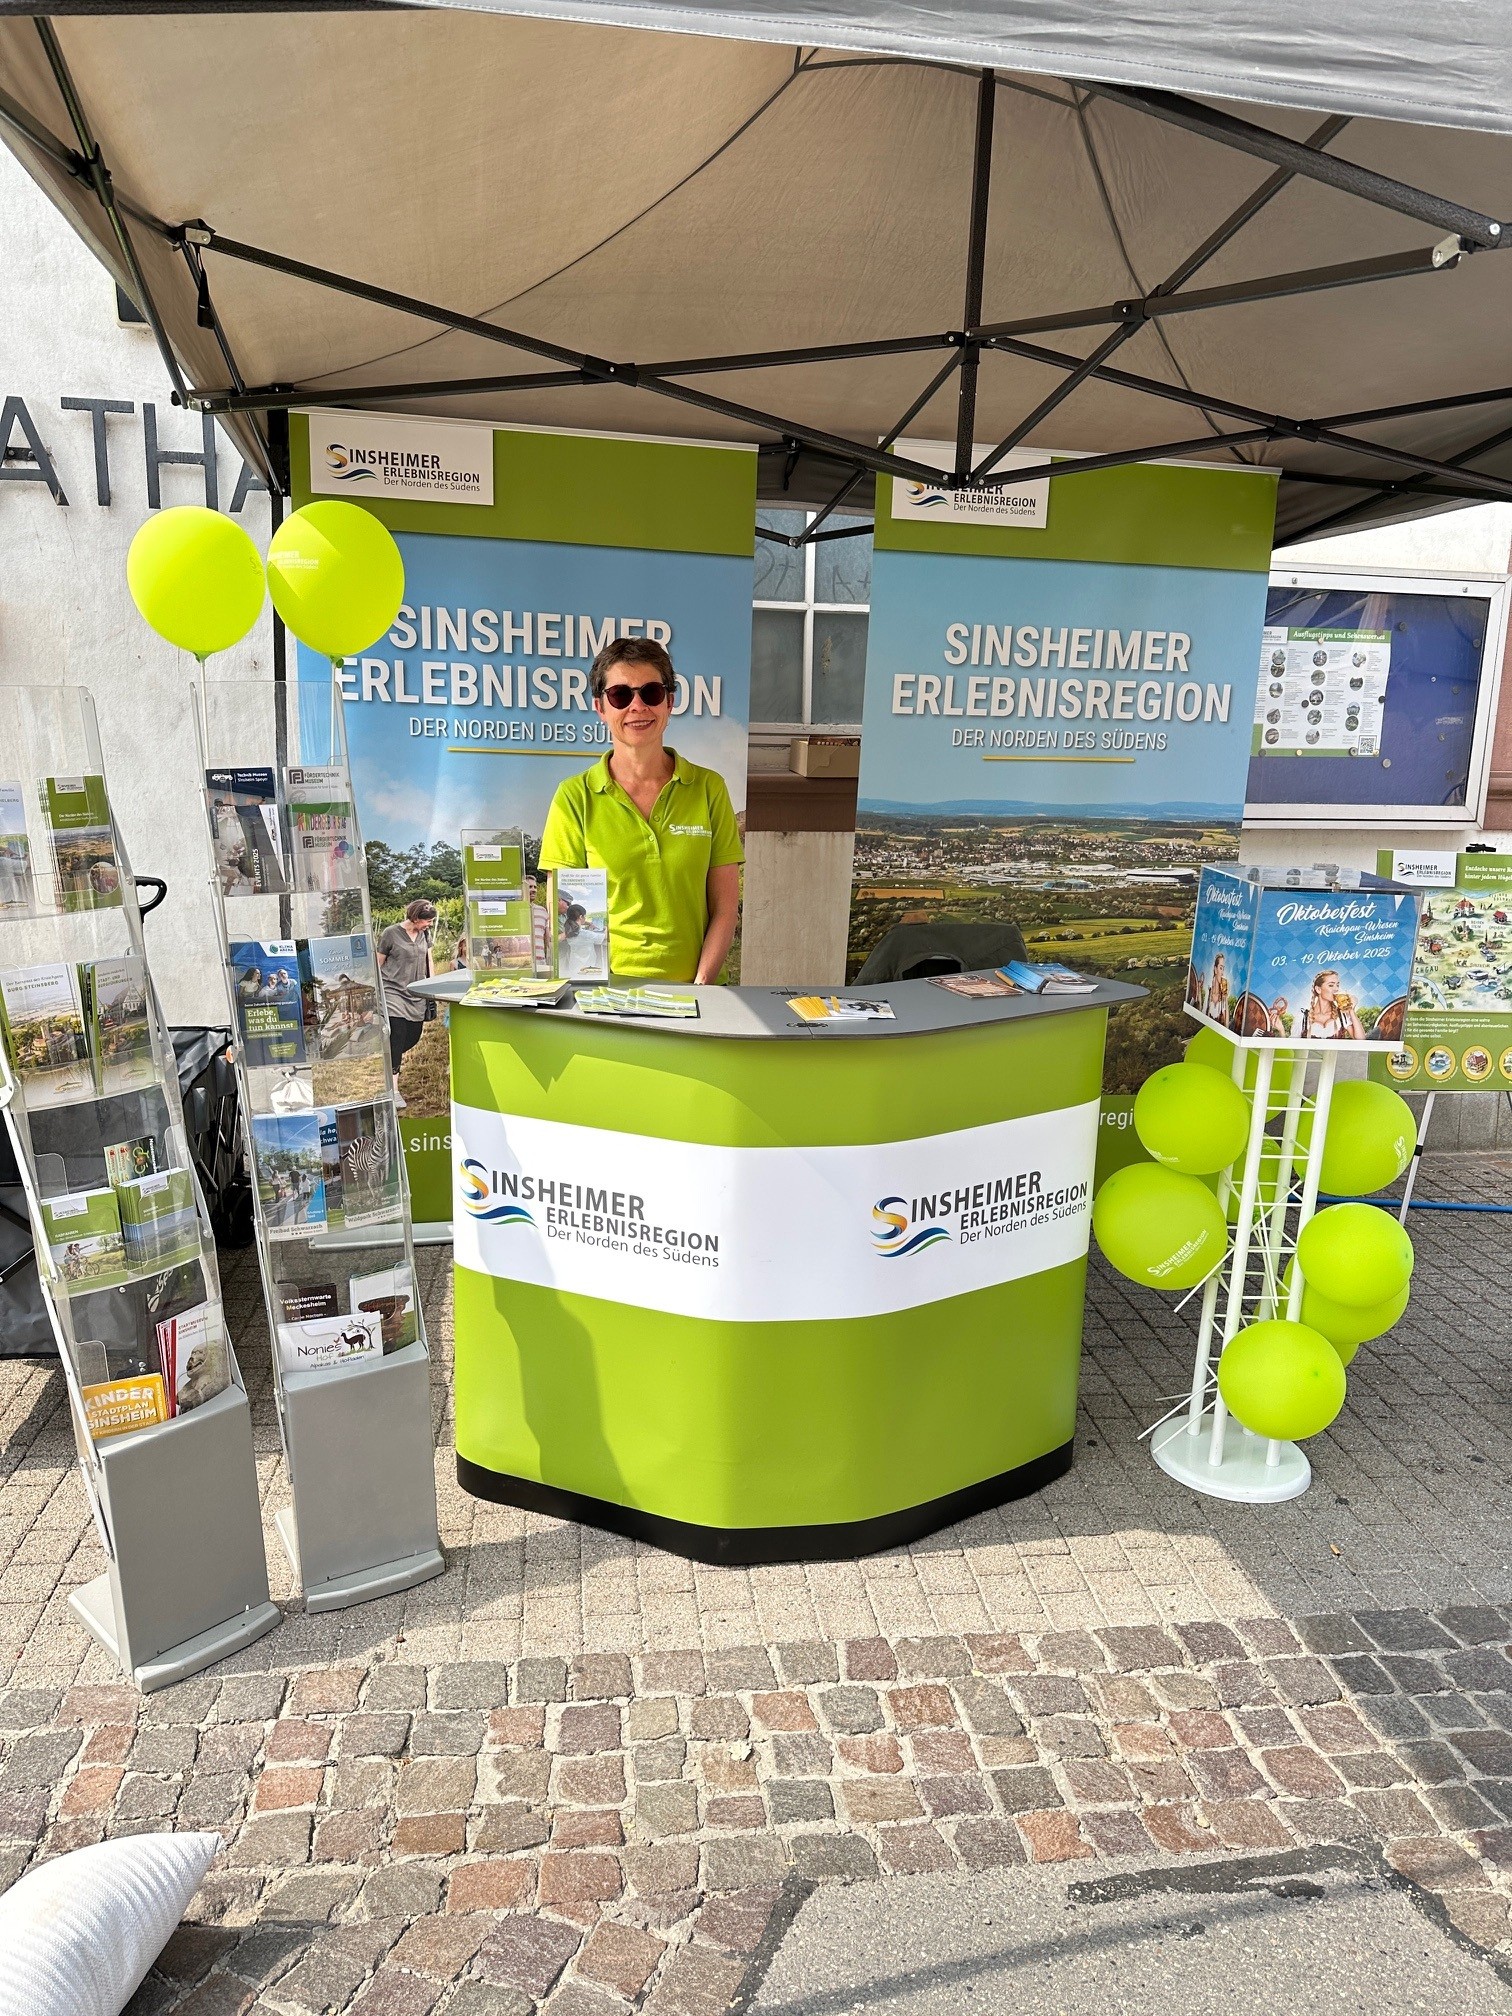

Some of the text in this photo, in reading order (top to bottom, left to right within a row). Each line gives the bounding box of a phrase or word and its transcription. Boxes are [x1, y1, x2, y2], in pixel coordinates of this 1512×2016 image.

[326, 443, 441, 470] SINSHEIMER
[383, 466, 480, 484] ERLEBNISREGION
[384, 477, 399, 486] Der
[401, 478, 432, 489] Norden
[434, 481, 449, 490] des
[954, 493, 1036, 508] ERLEBNISREGION
[954, 503, 1036, 516] Der Norden des Südens
[1334, 631, 1346, 639] und
[944, 622, 1192, 673] SINSHEIMER
[335, 656, 723, 718] ERLEBNISRON
[891, 673, 1232, 723] ERLEBNISREGION
[409, 717, 447, 738] DER
[454, 719, 535, 741] NORDEN
[541, 722, 578, 743] DES
[951, 728, 1168, 751] DER NORDEN DES SÜDENS
[252, 848, 260, 864] 2025
[1397, 862, 1438, 872] SINSHEIMER
[1480, 873, 1497, 882] jedem
[1276, 900, 1378, 926] Oktoberfest
[1314, 919, 1399, 938] Kraichgau-Wiesen
[1354, 931, 1395, 945] Sinsheim
[319, 955, 350, 965] SOMMER
[1271, 955, 1288, 967] 03.
[1301, 952, 1316, 965] 19.
[1316, 948, 1361, 965] Oktober
[1363, 947, 1392, 959] 2025
[24, 980, 59, 990] STEINSBERG
[247, 1008, 276, 1018] Erlebe,
[266, 1015, 277, 1023] du
[264, 1022, 294, 1030] kannst
[459, 1157, 646, 1221] SINSHEIMER
[871, 1170, 1043, 1241] SINSHEIMER
[959, 1180, 1089, 1232] ERLEBNISREGION
[269, 1223, 323, 1235] Freibad Schwarzach
[545, 1206, 720, 1253] ERLEBNISREGION
[959, 1199, 1088, 1246] Der Norden des Südens
[546, 1224, 720, 1269] Der Norden des Südens
[1146, 1240, 1193, 1276] SINSHEIMER
[279, 1293, 332, 1305] Volkssternwarte
[286, 1301, 327, 1311] Meckesheim
[297, 1343, 342, 1358] Nonies
[315, 1352, 334, 1362] Hof
[84, 1386, 154, 1412] KINDER
[91, 1401, 149, 1418] STADTPLAN
[88, 1407, 157, 1430] SINSHEIM
